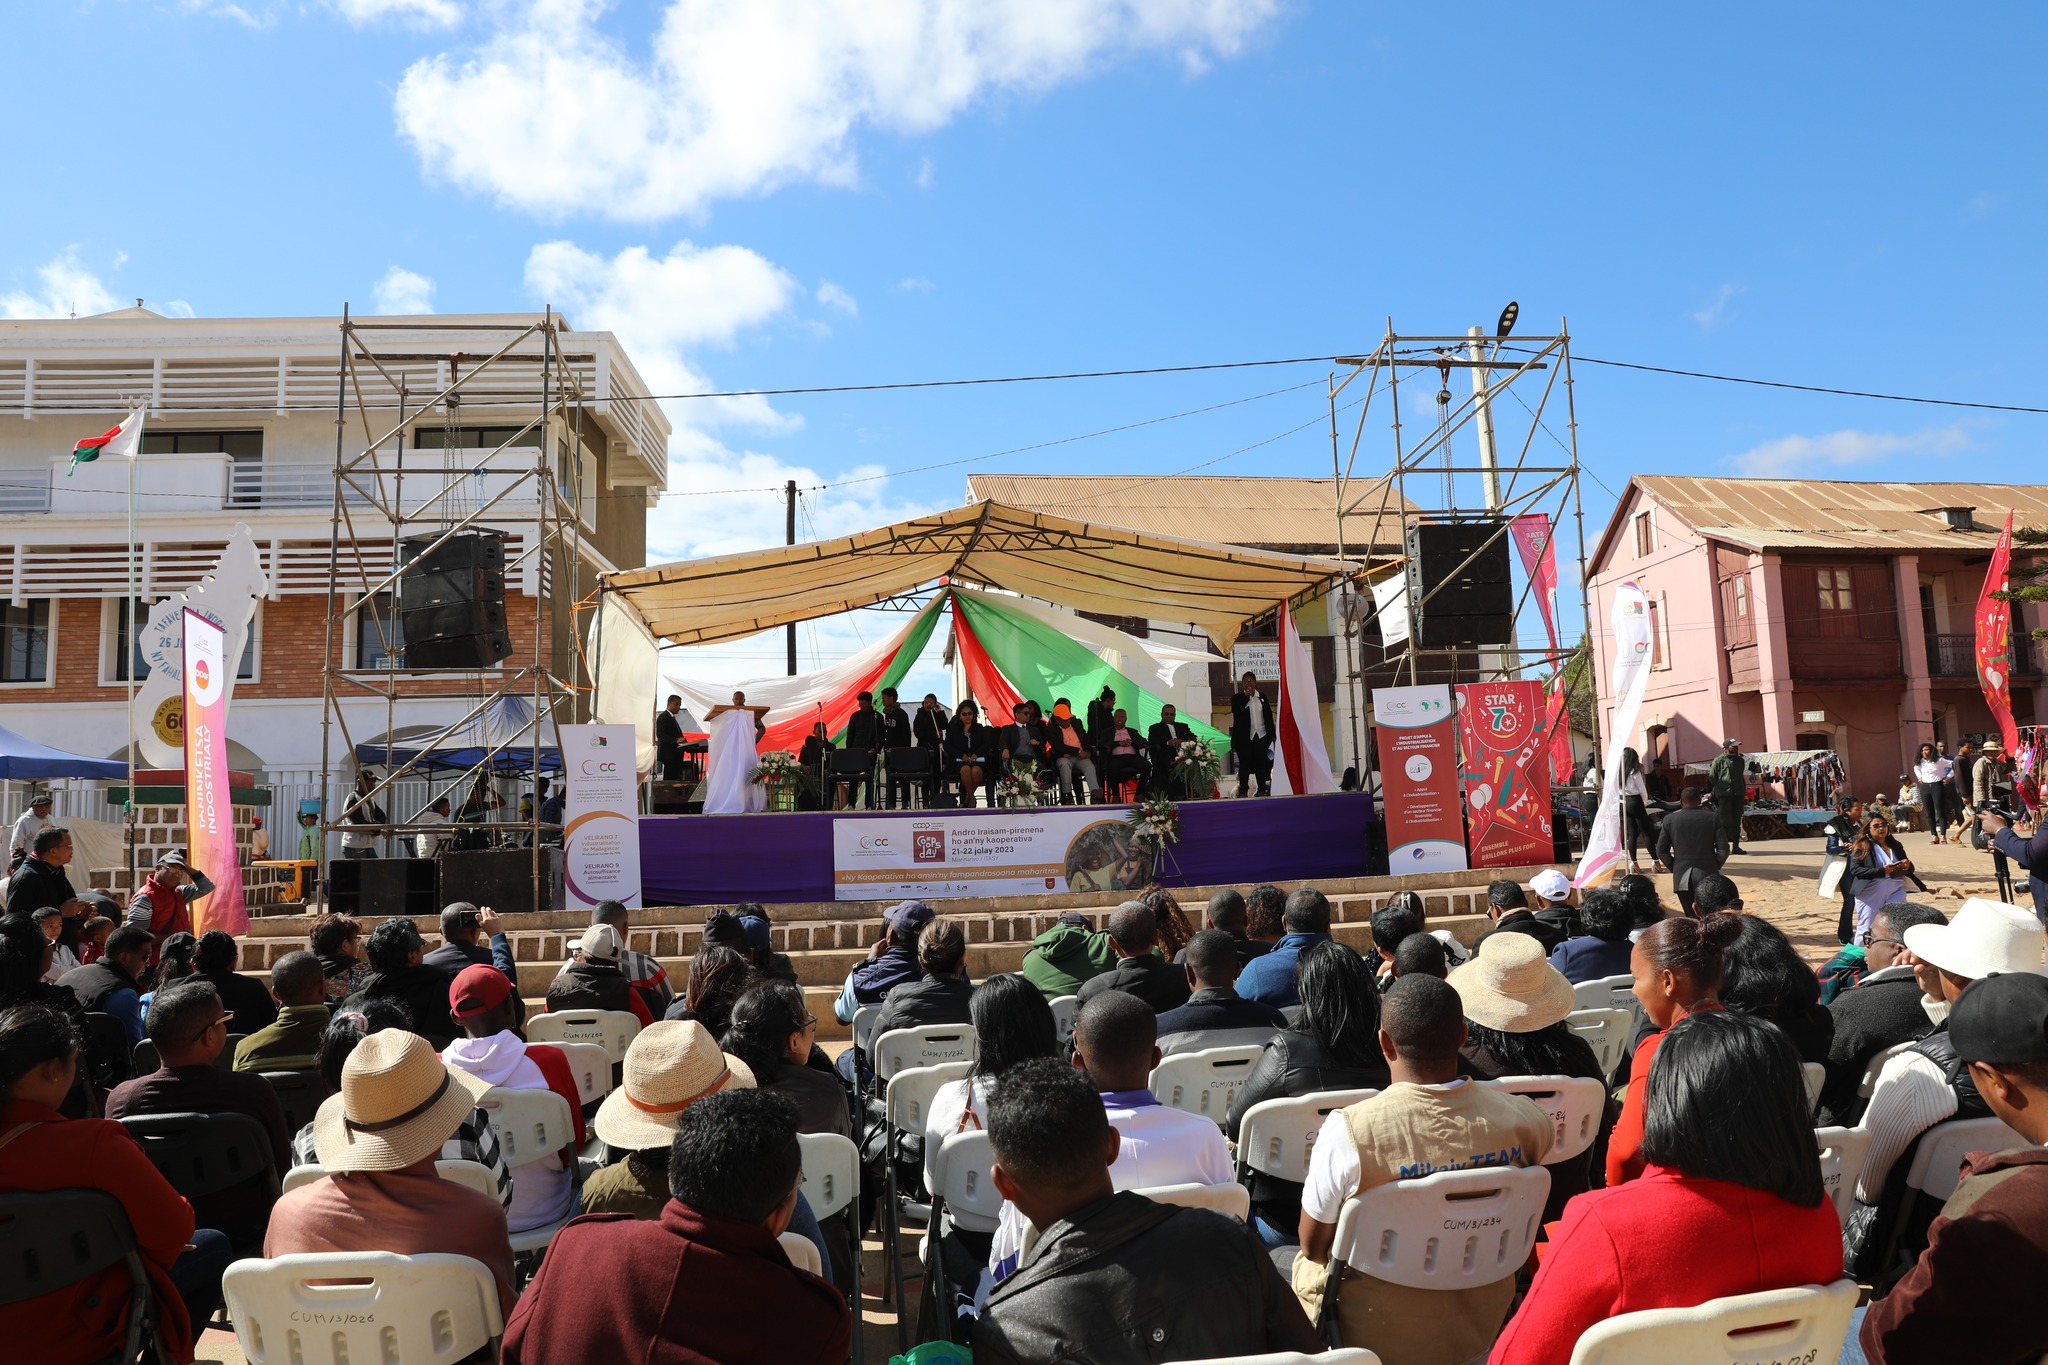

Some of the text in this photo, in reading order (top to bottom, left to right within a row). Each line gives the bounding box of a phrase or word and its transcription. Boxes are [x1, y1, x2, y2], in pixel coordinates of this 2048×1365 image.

[1484, 693, 1516, 706] STAR
[1487, 706, 1517, 732] 70
[203, 723, 217, 834] INDOSTRIALY
[986, 836, 1032, 844] kaoperativa
[1481, 841, 1509, 852] ENSEMBLE
[974, 847, 993, 855] jolay
[1481, 842, 1536, 861] BRILLONS PLUS FORT
[858, 873, 904, 881] Kaoperativa
[949, 870, 1016, 880] fampandrosoana
[1443, 1217, 1502, 1231] CUM/3/234
[290, 1310, 375, 1324] CUM/3/026
